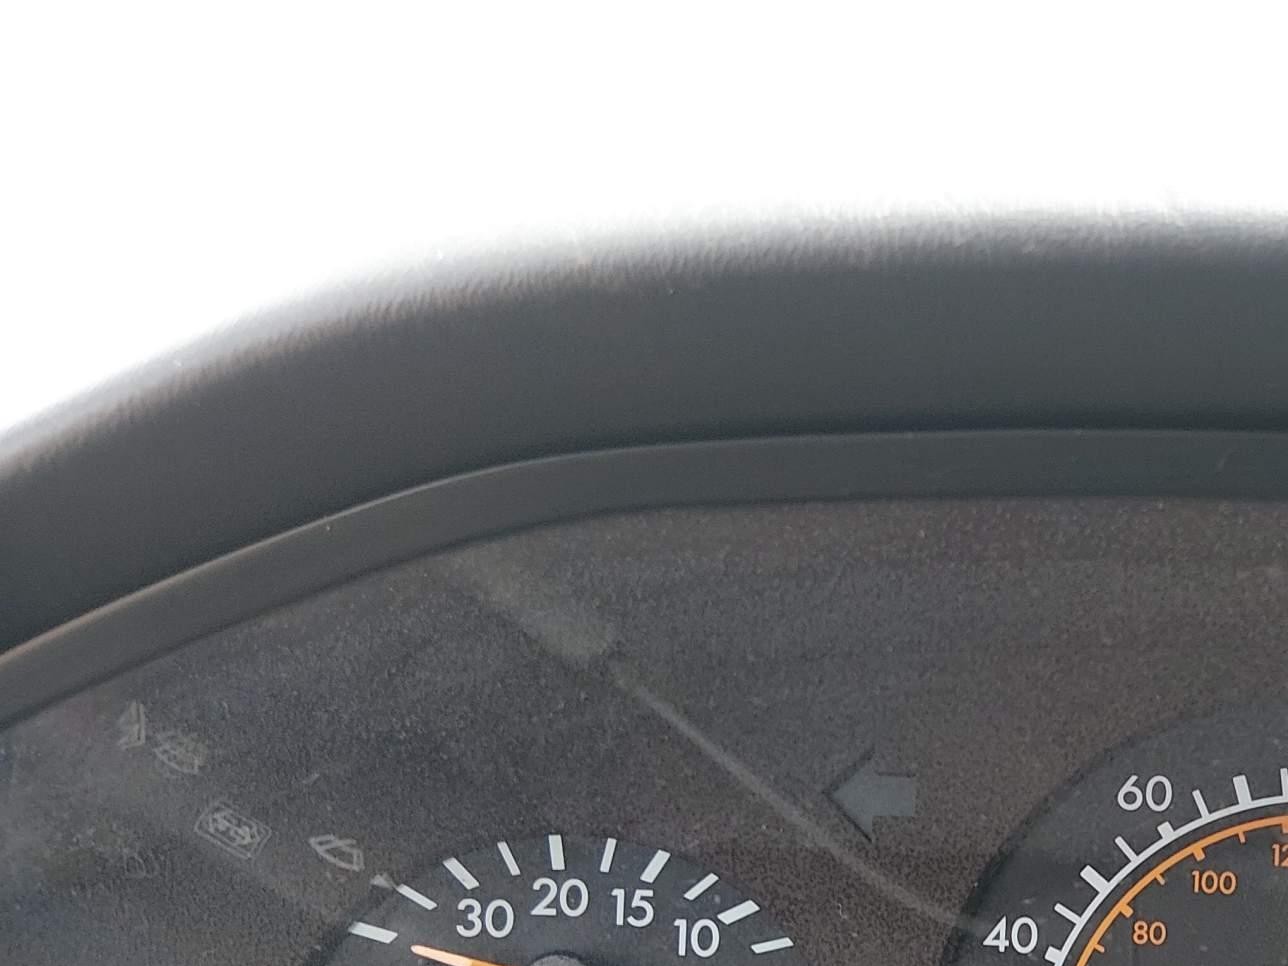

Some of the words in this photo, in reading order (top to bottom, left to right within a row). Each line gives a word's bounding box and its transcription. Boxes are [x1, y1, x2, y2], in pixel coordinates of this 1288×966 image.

[1118, 776, 1172, 811] 60
[531, 878, 588, 916] 20
[1194, 870, 1237, 894] 100
[456, 899, 513, 937] 30
[612, 889, 653, 927] 15
[674, 918, 720, 957] 10
[983, 917, 1037, 953] 40
[1133, 921, 1165, 944] 80
